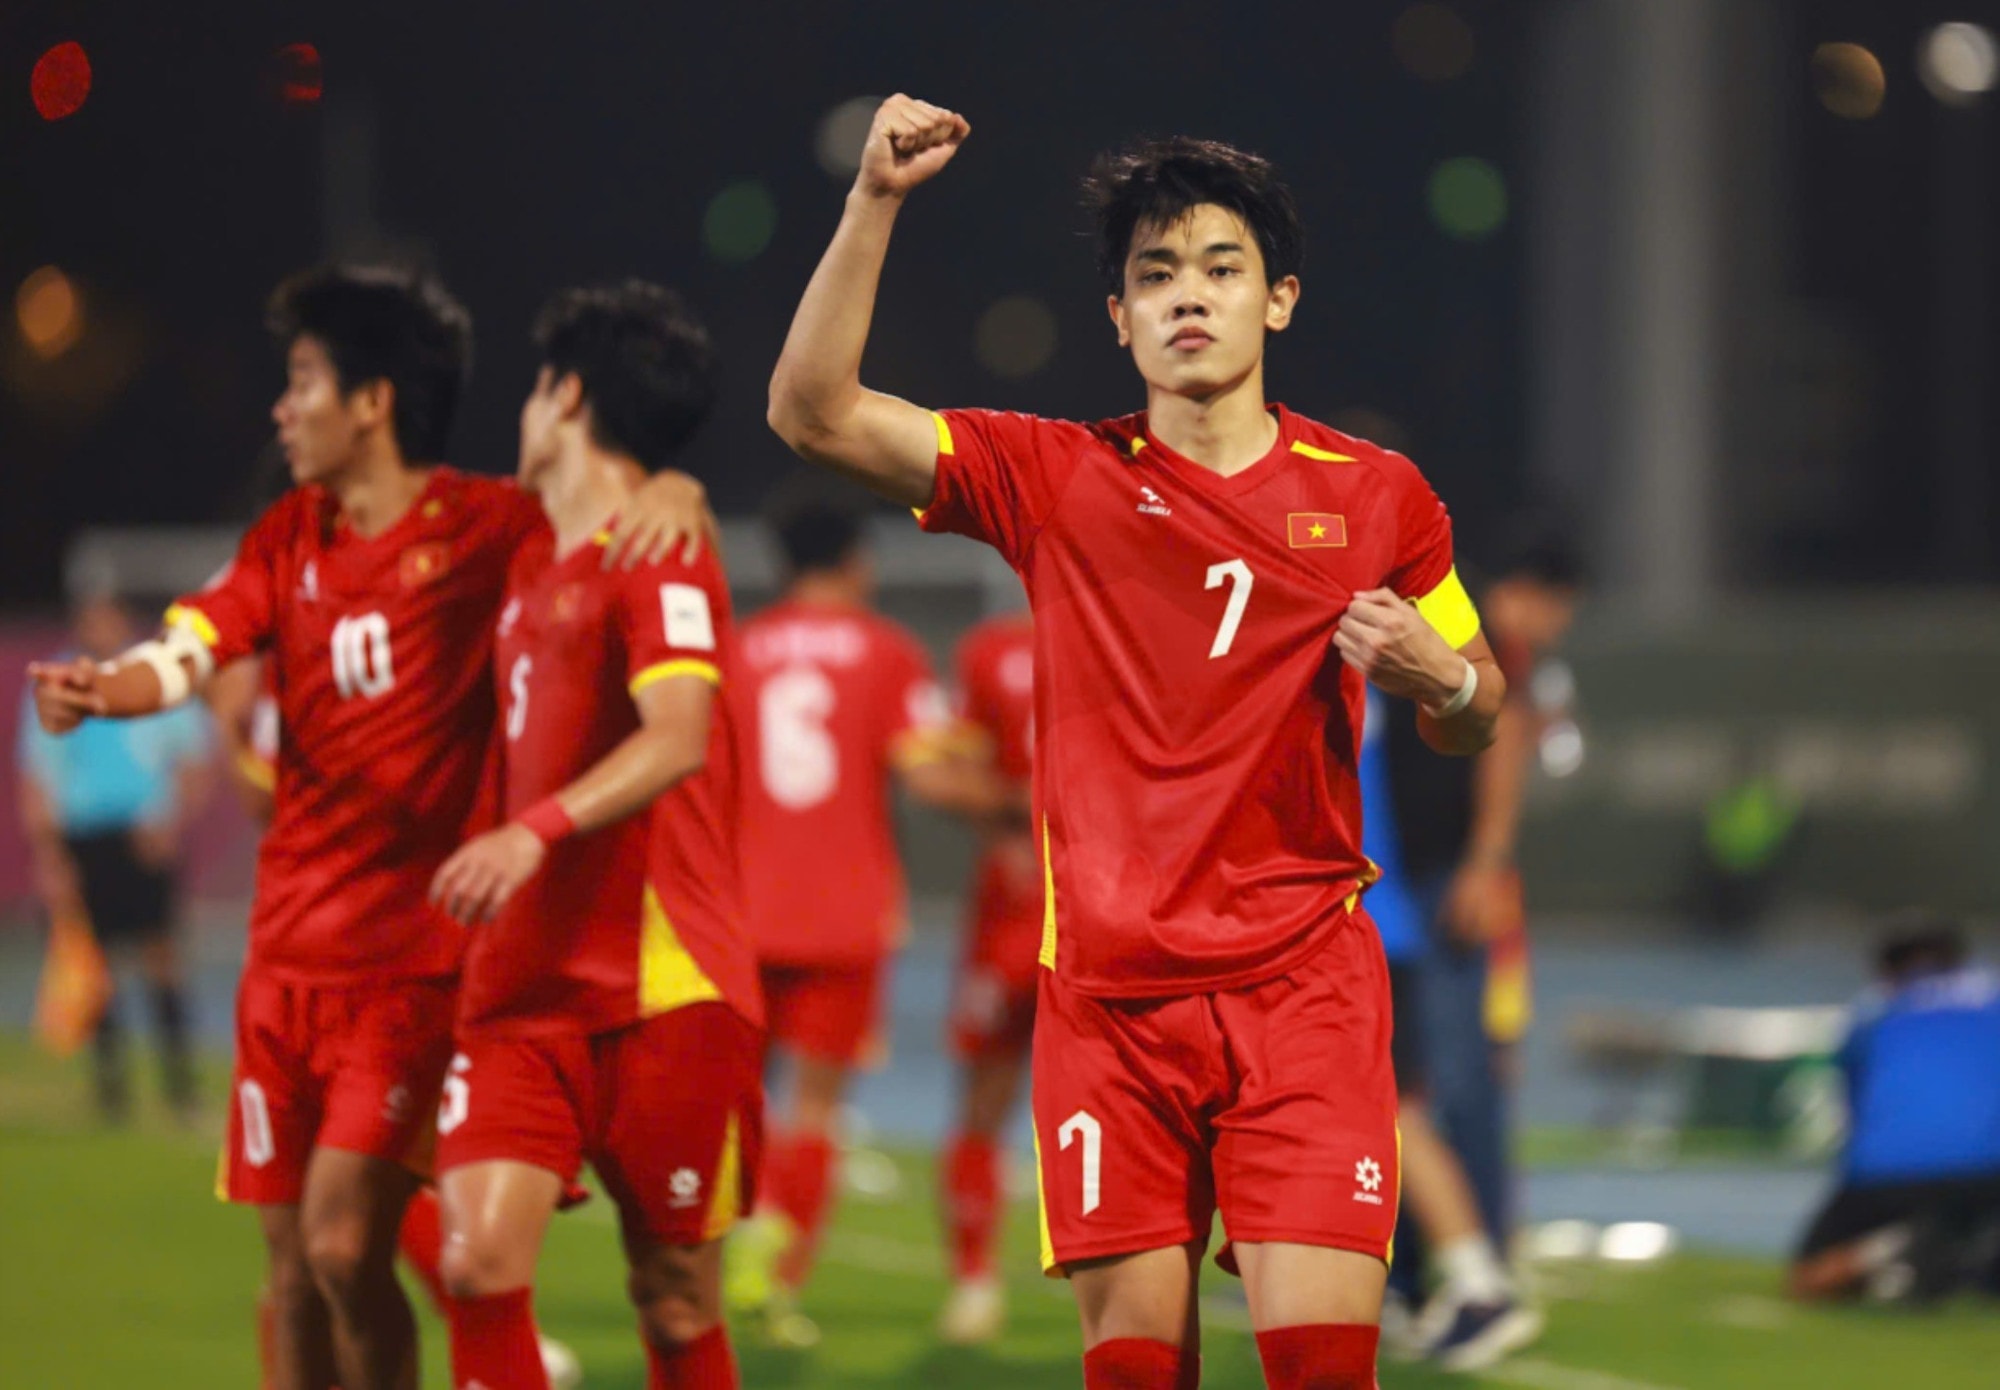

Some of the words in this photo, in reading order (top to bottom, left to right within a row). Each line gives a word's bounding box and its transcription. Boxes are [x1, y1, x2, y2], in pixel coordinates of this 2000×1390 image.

[330, 611, 394, 699] 10
[1204, 558, 1255, 659] 7
[506, 653, 532, 741] 5
[758, 670, 839, 809] 6
[1058, 1110, 1101, 1216] 7
